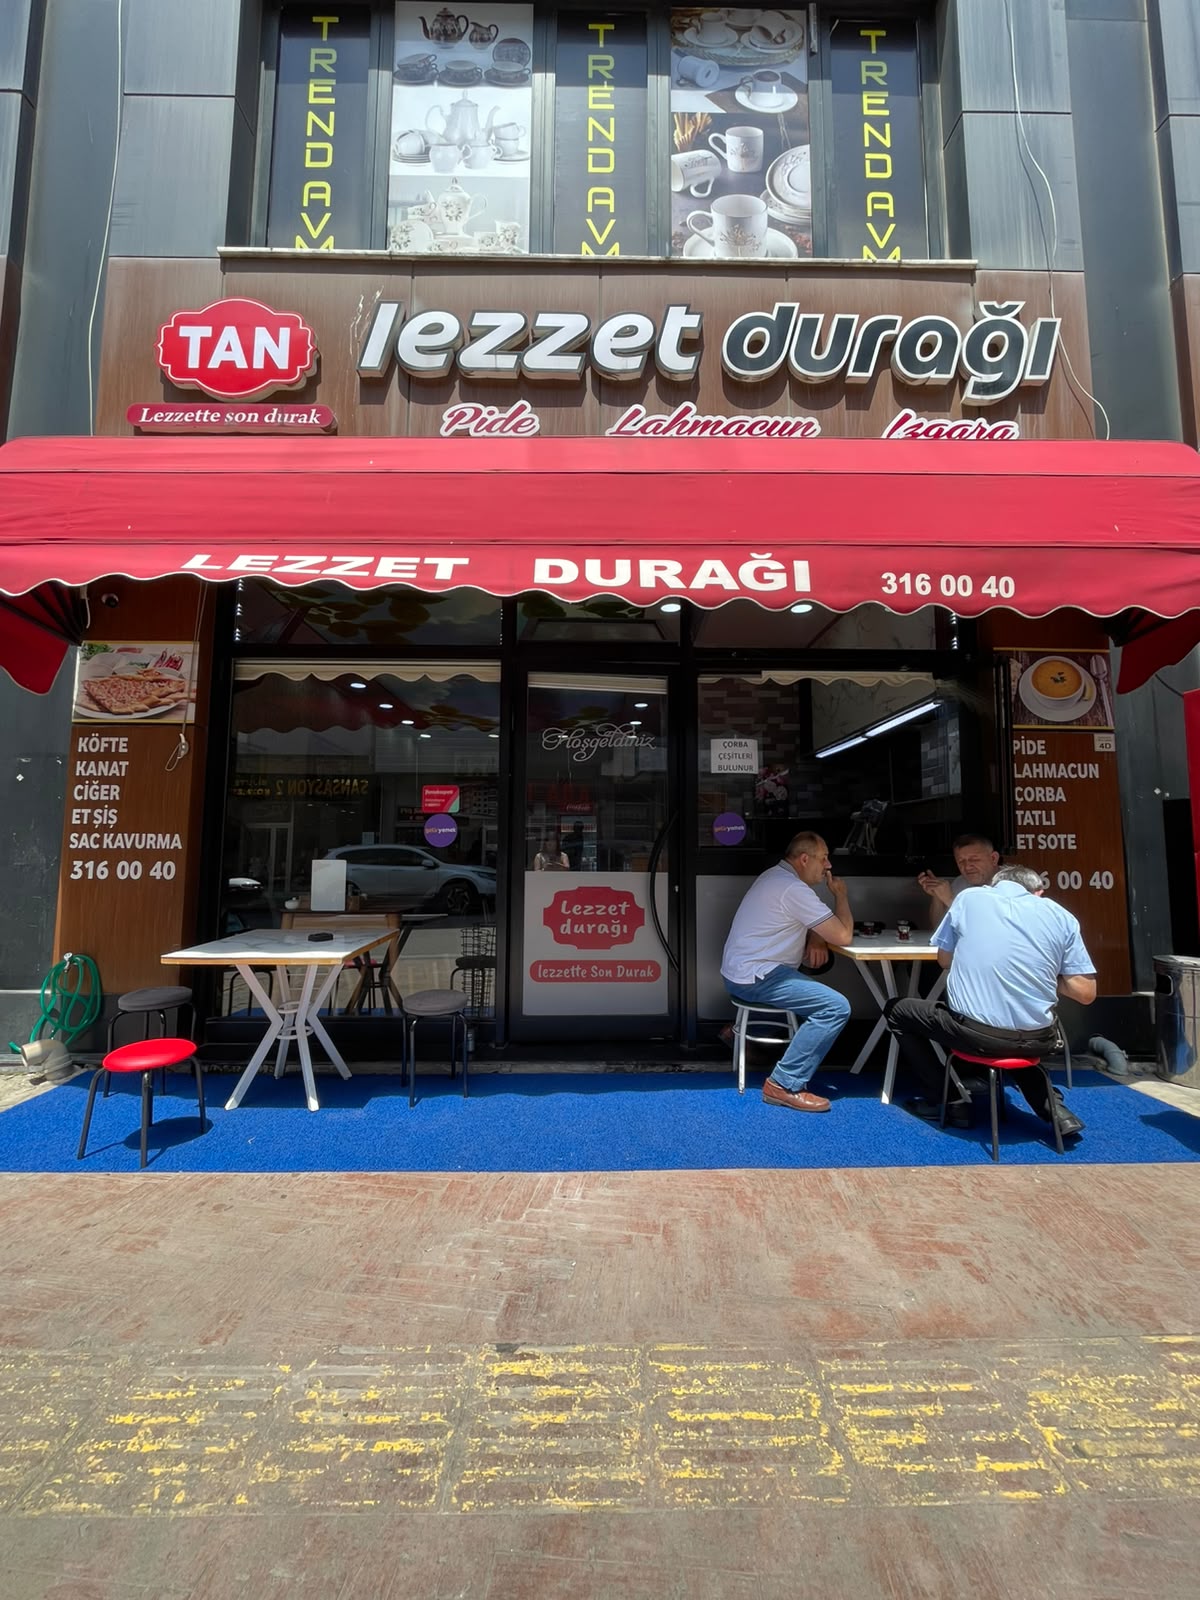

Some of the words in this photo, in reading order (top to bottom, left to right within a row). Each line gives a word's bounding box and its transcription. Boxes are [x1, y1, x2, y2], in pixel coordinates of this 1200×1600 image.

[305, 16, 339, 168] TREND
[588, 24, 615, 173] TREND
[860, 30, 893, 179] TREND
[178, 325, 291, 370] TAN
[359, 301, 701, 380] lezzet
[723, 302, 1062, 405] durağı
[139, 407, 221, 424] Lezzette
[224, 411, 259, 424] son
[264, 408, 322, 425] durak
[441, 401, 543, 434] Pide
[607, 402, 820, 437] Lahmacun
[181, 554, 470, 580] LEZZET
[533, 552, 811, 592] DURAĞI
[881, 572, 932, 596] 316
[940, 574, 973, 597] 00
[981, 575, 1015, 598] 40
[78, 733, 129, 753] KÖFTE
[722, 741, 748, 749] ÇORBA
[1012, 735, 1047, 755] PİDE
[1099, 742, 1112, 750] 4D
[75, 760, 129, 777] KANAT
[717, 764, 754, 772] BULUNUR
[1013, 762, 1100, 779] LAHMACUN
[73, 780, 120, 802] CİĞER
[1014, 786, 1067, 806] ÇORBA
[71, 808, 91, 825] ET
[92, 804, 118, 828] ŞİŞ
[1015, 809, 1056, 826] TATLI
[69, 832, 100, 849] SAC
[102, 833, 182, 850] KAVURMA
[1016, 833, 1035, 850] ET
[1037, 833, 1077, 850] SOTE
[70, 860, 109, 880] 316
[116, 860, 143, 880] 00
[149, 860, 176, 880] 40
[1057, 870, 1083, 890] 00
[1089, 870, 1114, 890] 40
[559, 918, 628, 937] durağı
[590, 965, 612, 978] Son
[616, 965, 654, 978] Durak
